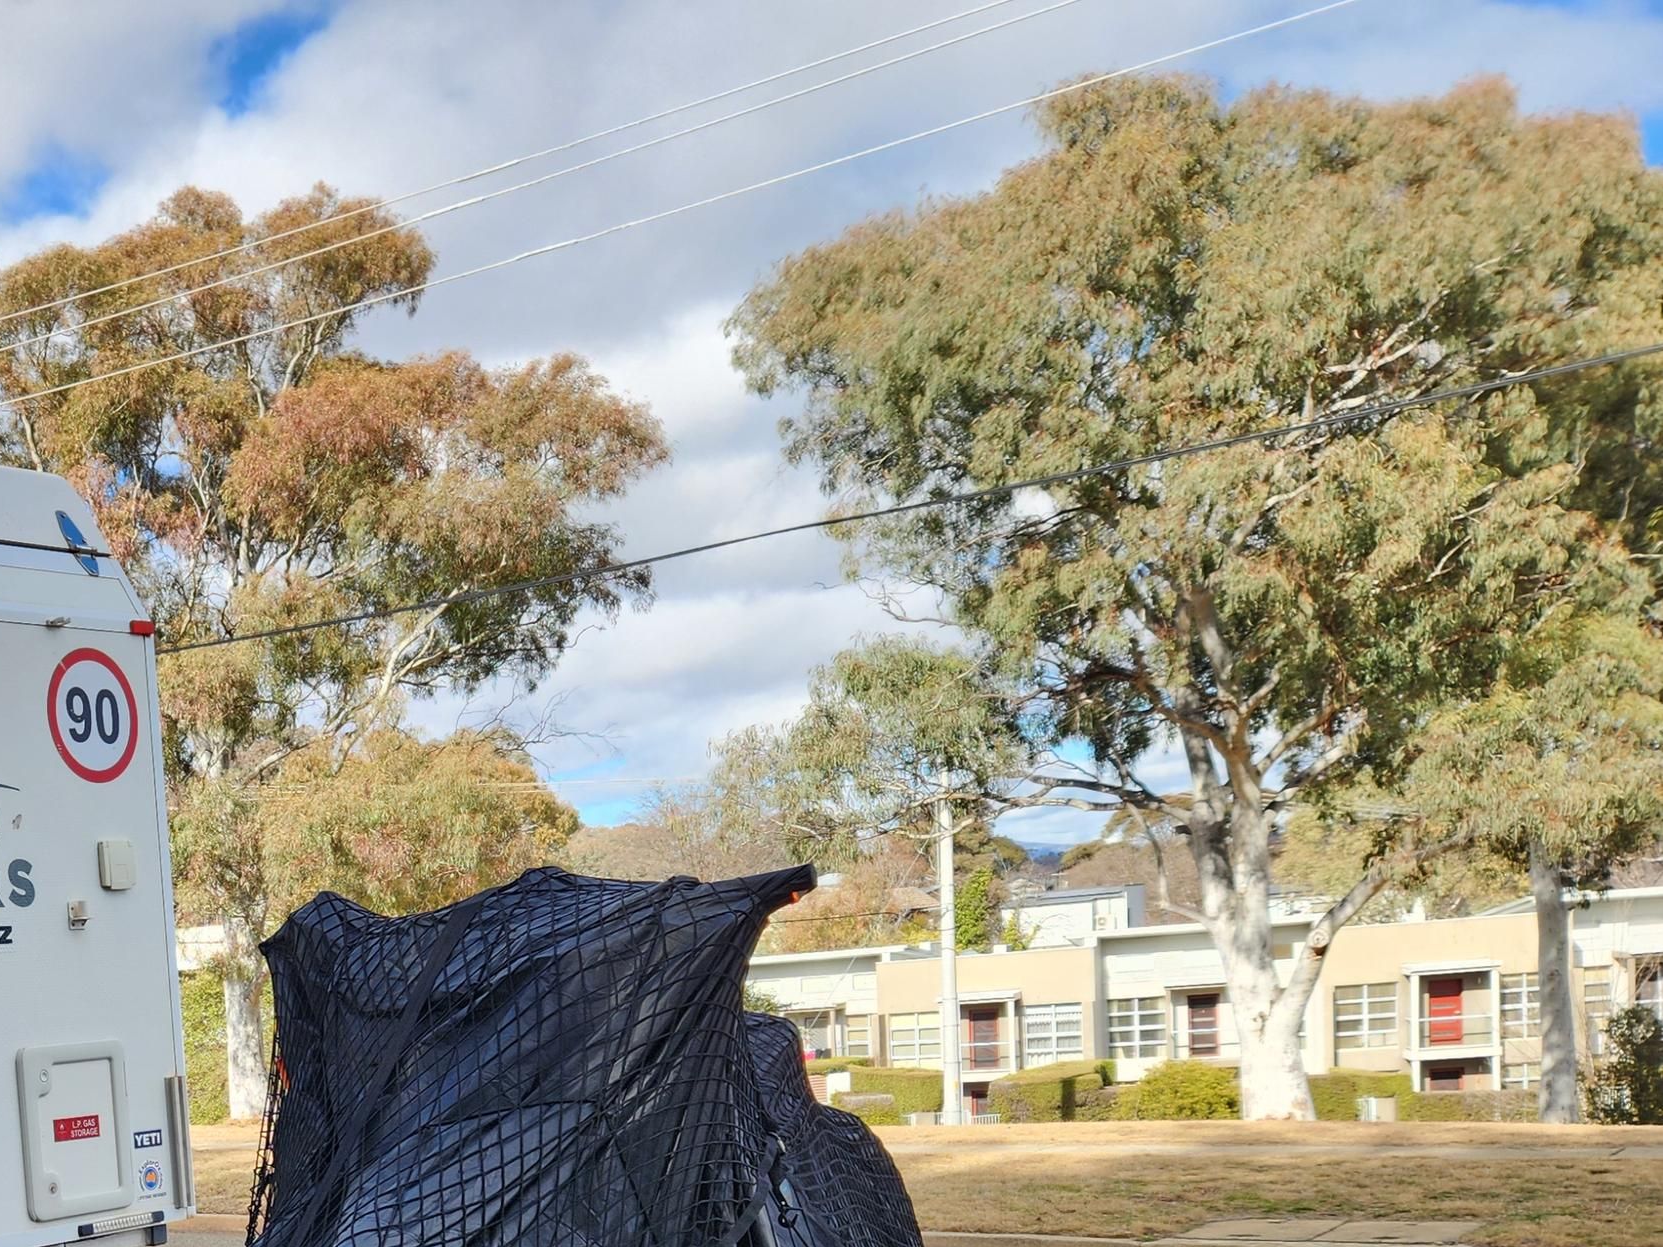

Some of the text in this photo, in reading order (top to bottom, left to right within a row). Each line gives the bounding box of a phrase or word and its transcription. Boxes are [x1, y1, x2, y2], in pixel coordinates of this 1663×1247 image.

[65, 686, 120, 745] 90
[83, 1118, 96, 1128] GAS
[70, 1126, 99, 1138] STORAGE
[134, 1132, 161, 1147] YETI
